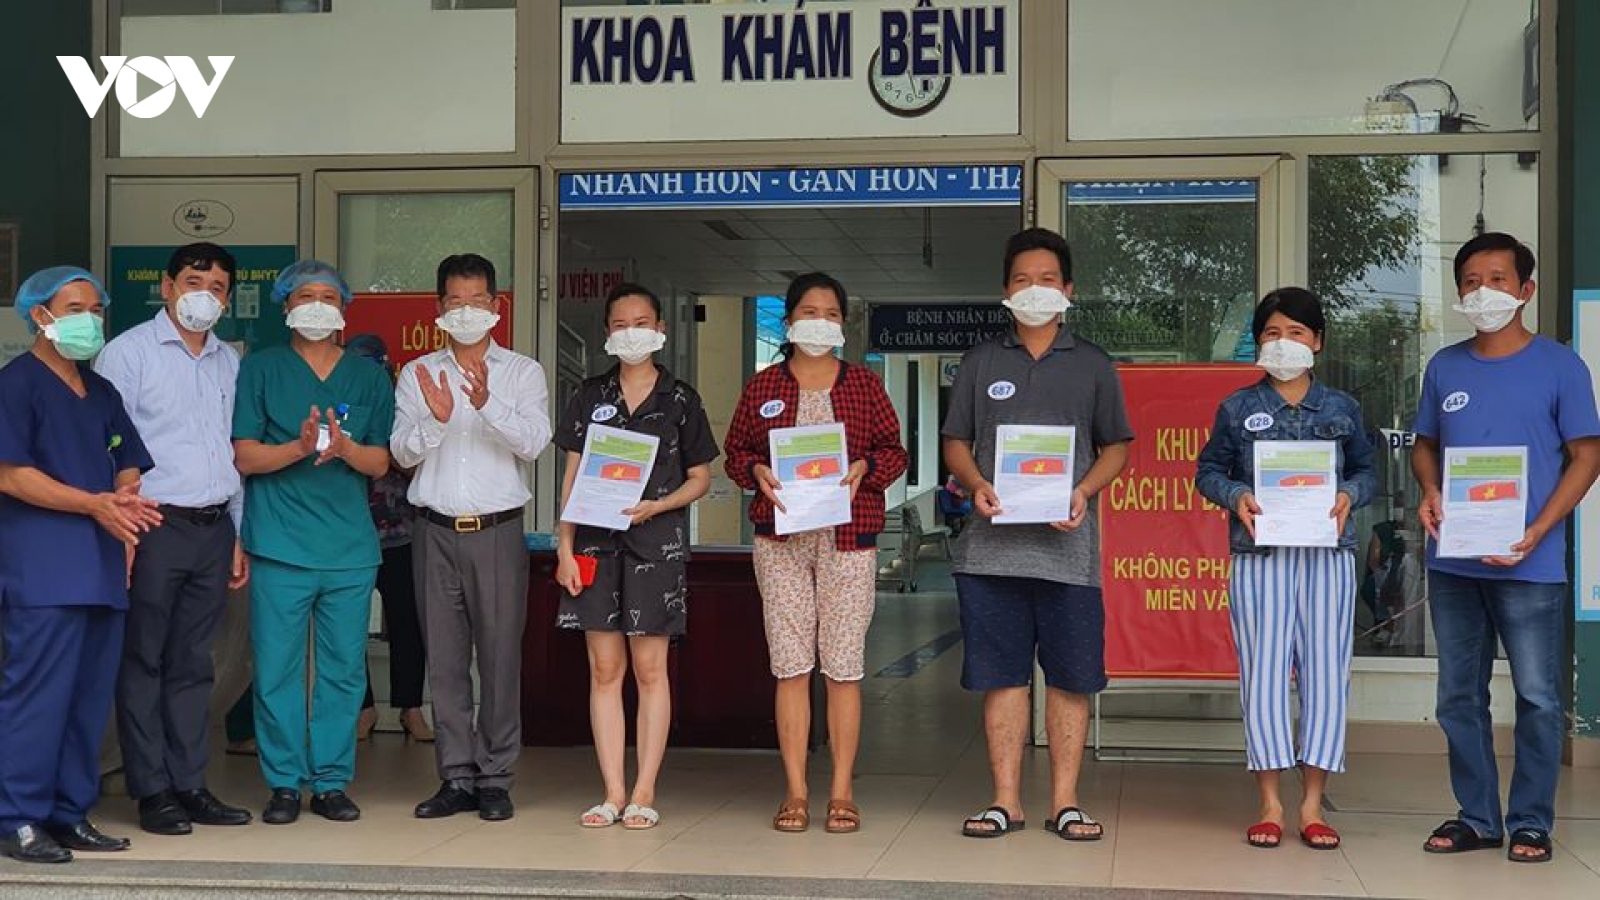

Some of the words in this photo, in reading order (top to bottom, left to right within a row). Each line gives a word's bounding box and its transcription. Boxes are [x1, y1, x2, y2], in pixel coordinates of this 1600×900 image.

[571, 16, 696, 84] KHOA
[722, 0, 853, 82] KHÁM
[569, 172, 685, 195] NHANH
[991, 384, 1013, 396] 687
[1446, 394, 1467, 409] 642
[1156, 427, 1199, 461] KHU
[1110, 467, 1167, 511] CÁCH
[1173, 477, 1196, 511] LY
[1114, 550, 1191, 579] KHÔNG
